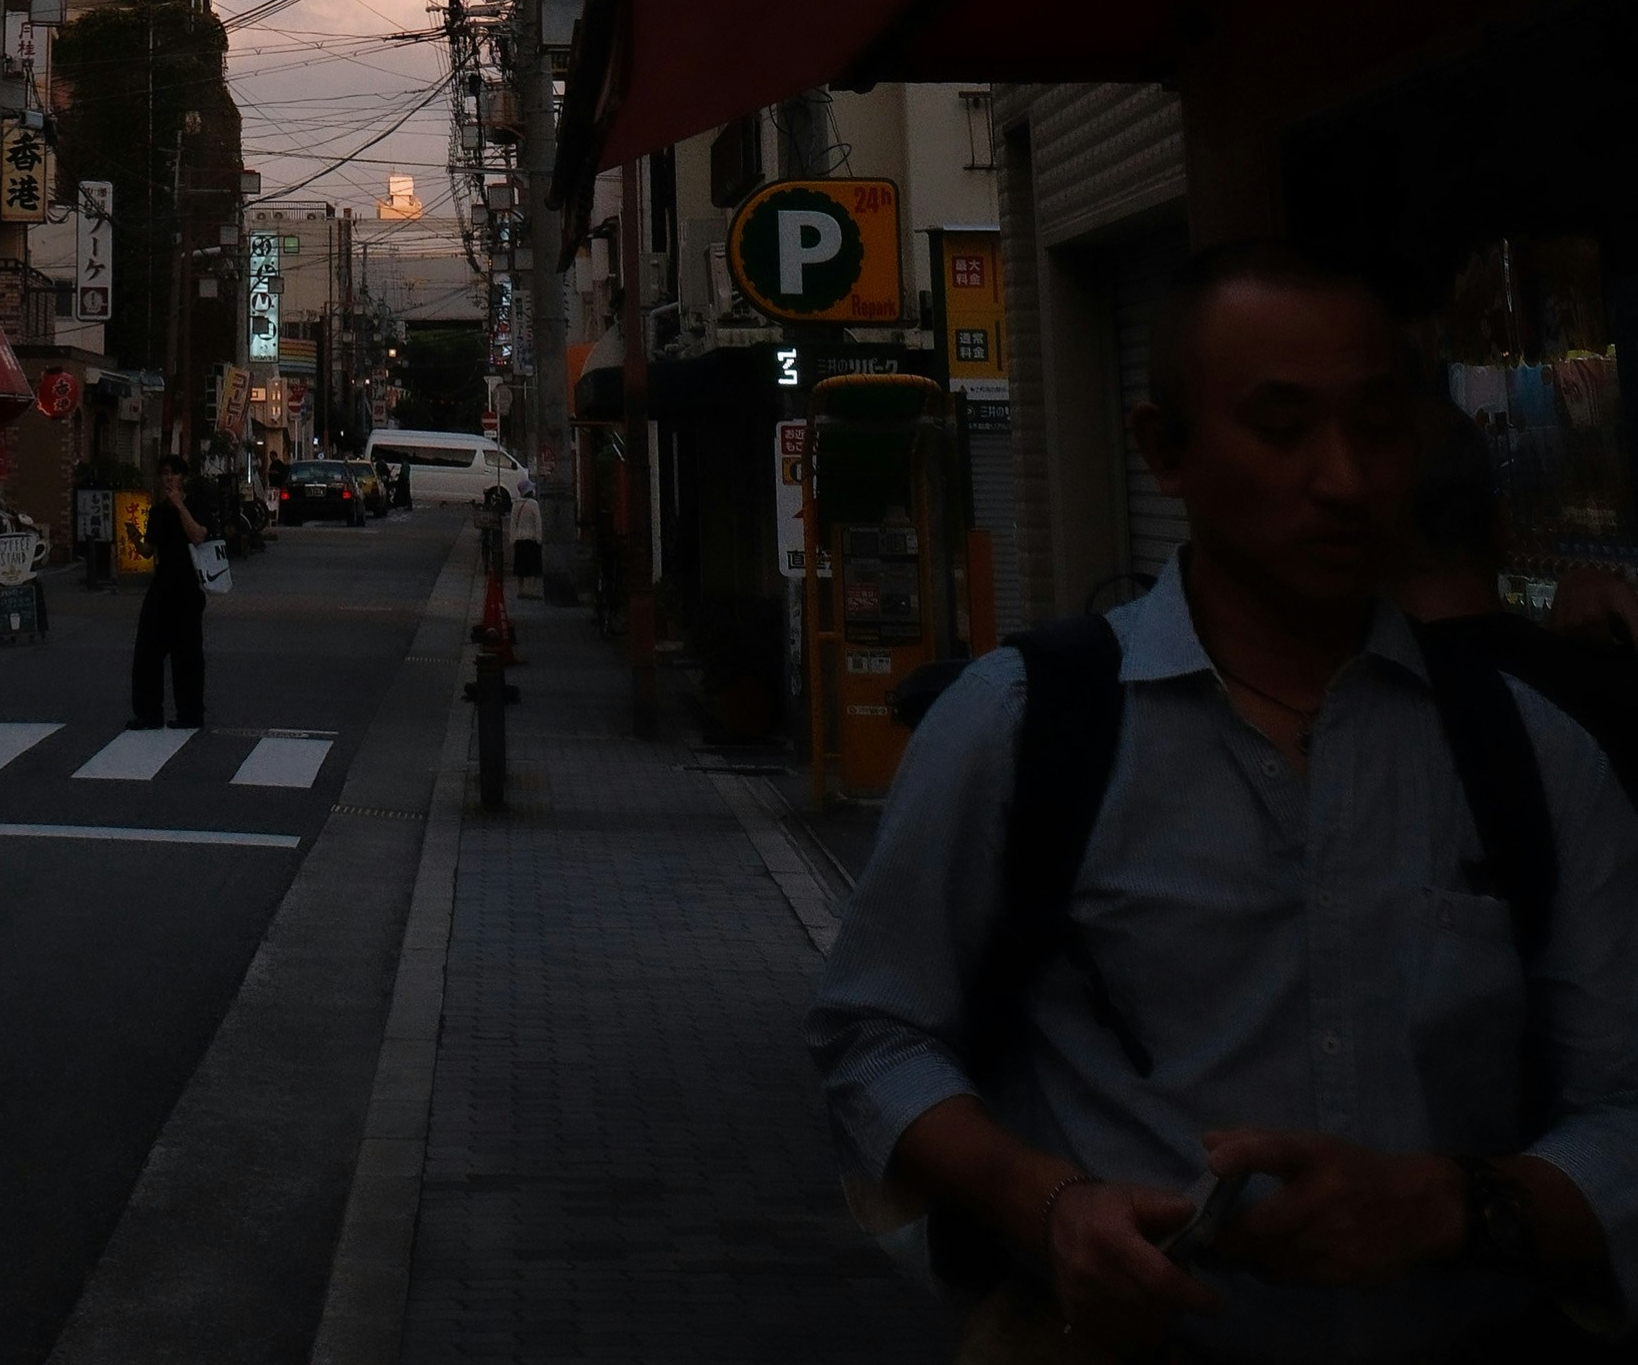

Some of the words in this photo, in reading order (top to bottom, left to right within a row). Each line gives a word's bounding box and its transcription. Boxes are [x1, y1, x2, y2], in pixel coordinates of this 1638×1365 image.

[6, 132, 42, 212] 香港
[854, 186, 892, 214] 24h
[777, 210, 843, 295] P
[851, 294, 897, 317] Repark
[817, 357, 898, 374] 三井のリパーク
[226, 372, 247, 426] コーヒー
[0, 552, 27, 567] STAND
